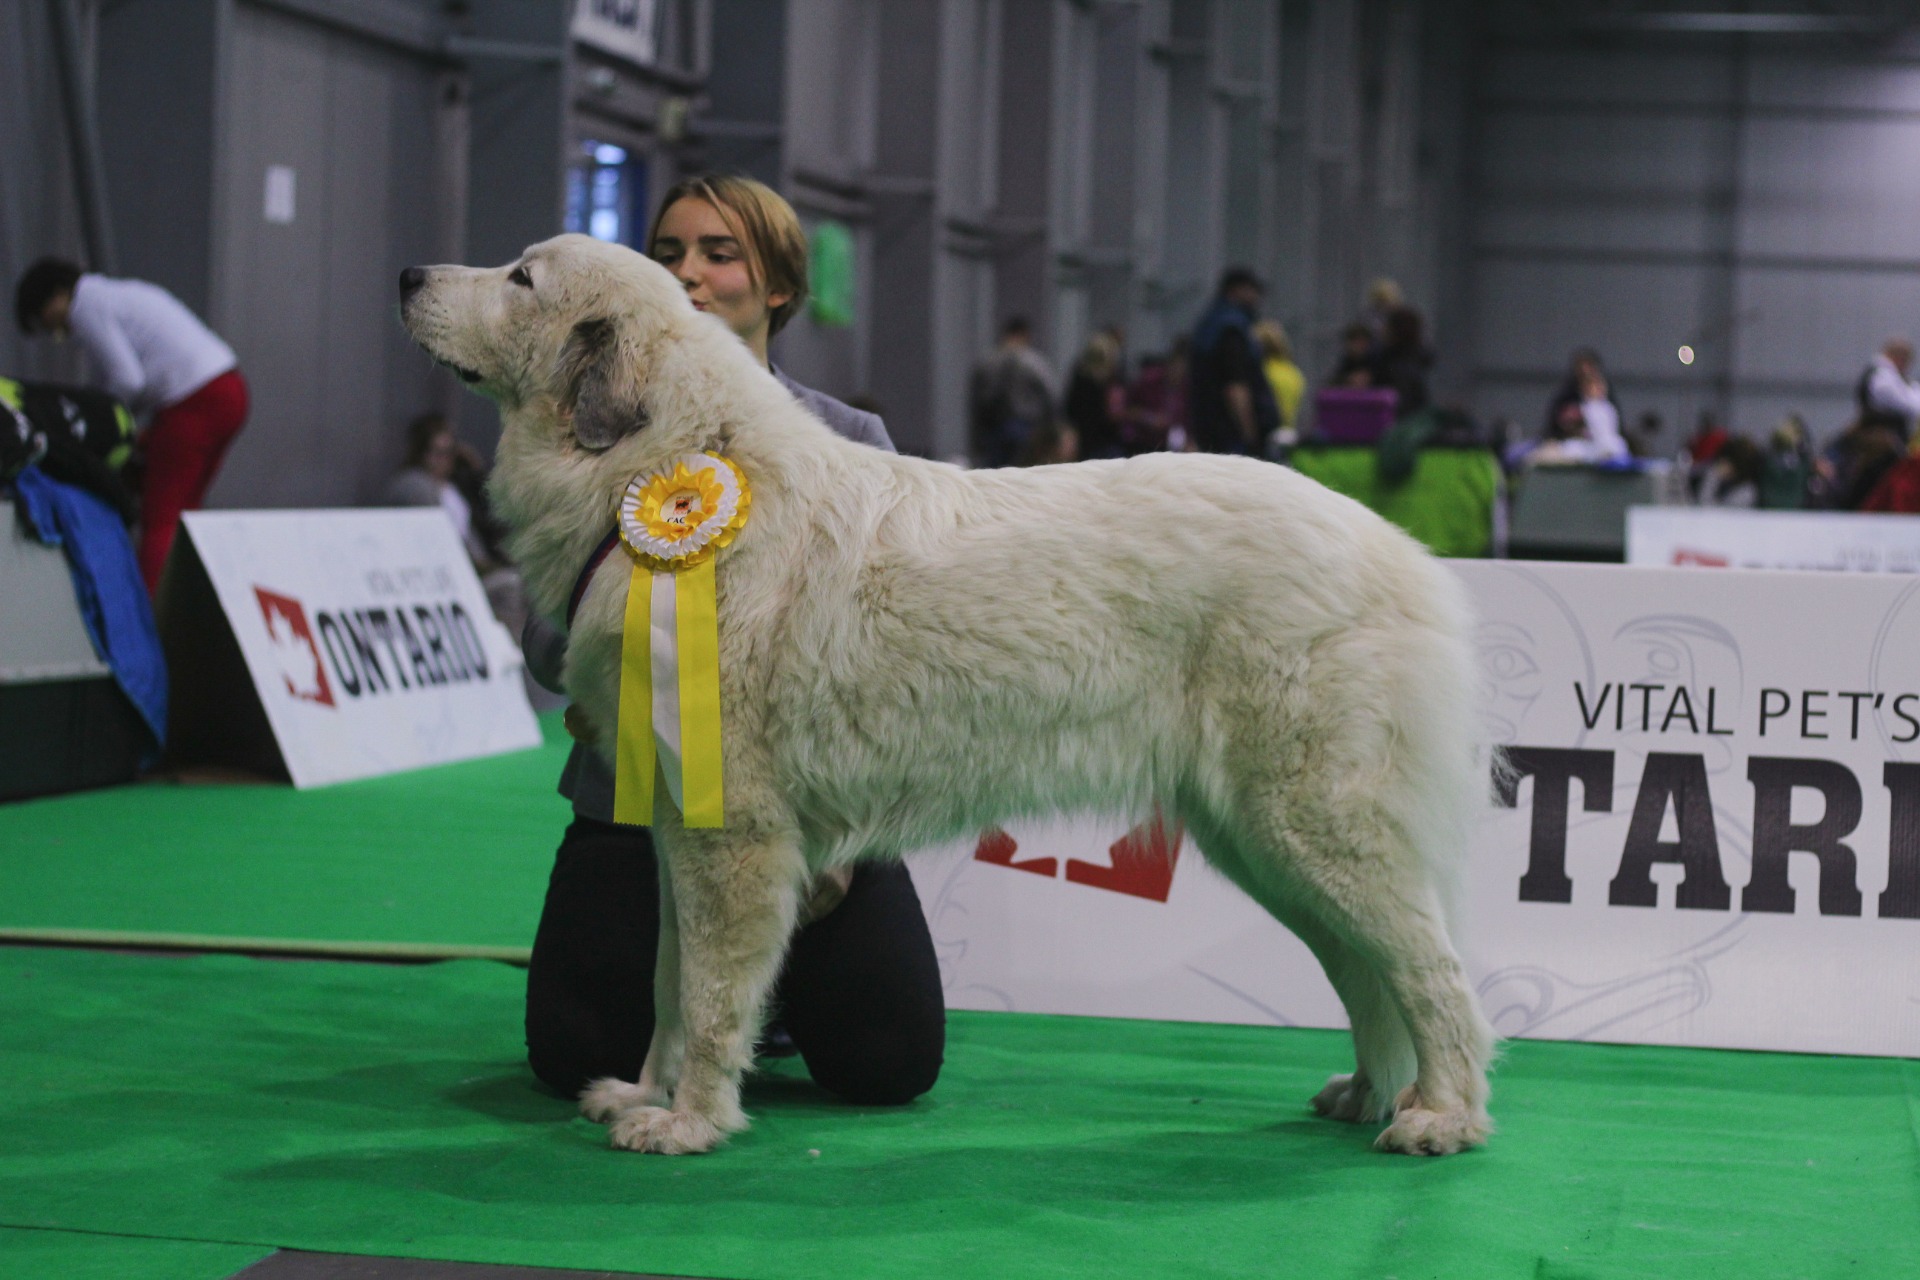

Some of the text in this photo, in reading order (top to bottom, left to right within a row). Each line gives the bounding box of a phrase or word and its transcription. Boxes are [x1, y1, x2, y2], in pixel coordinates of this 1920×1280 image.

[317, 602, 489, 696] ONTARIO
[1574, 682, 1920, 742] VITAL PET'S
